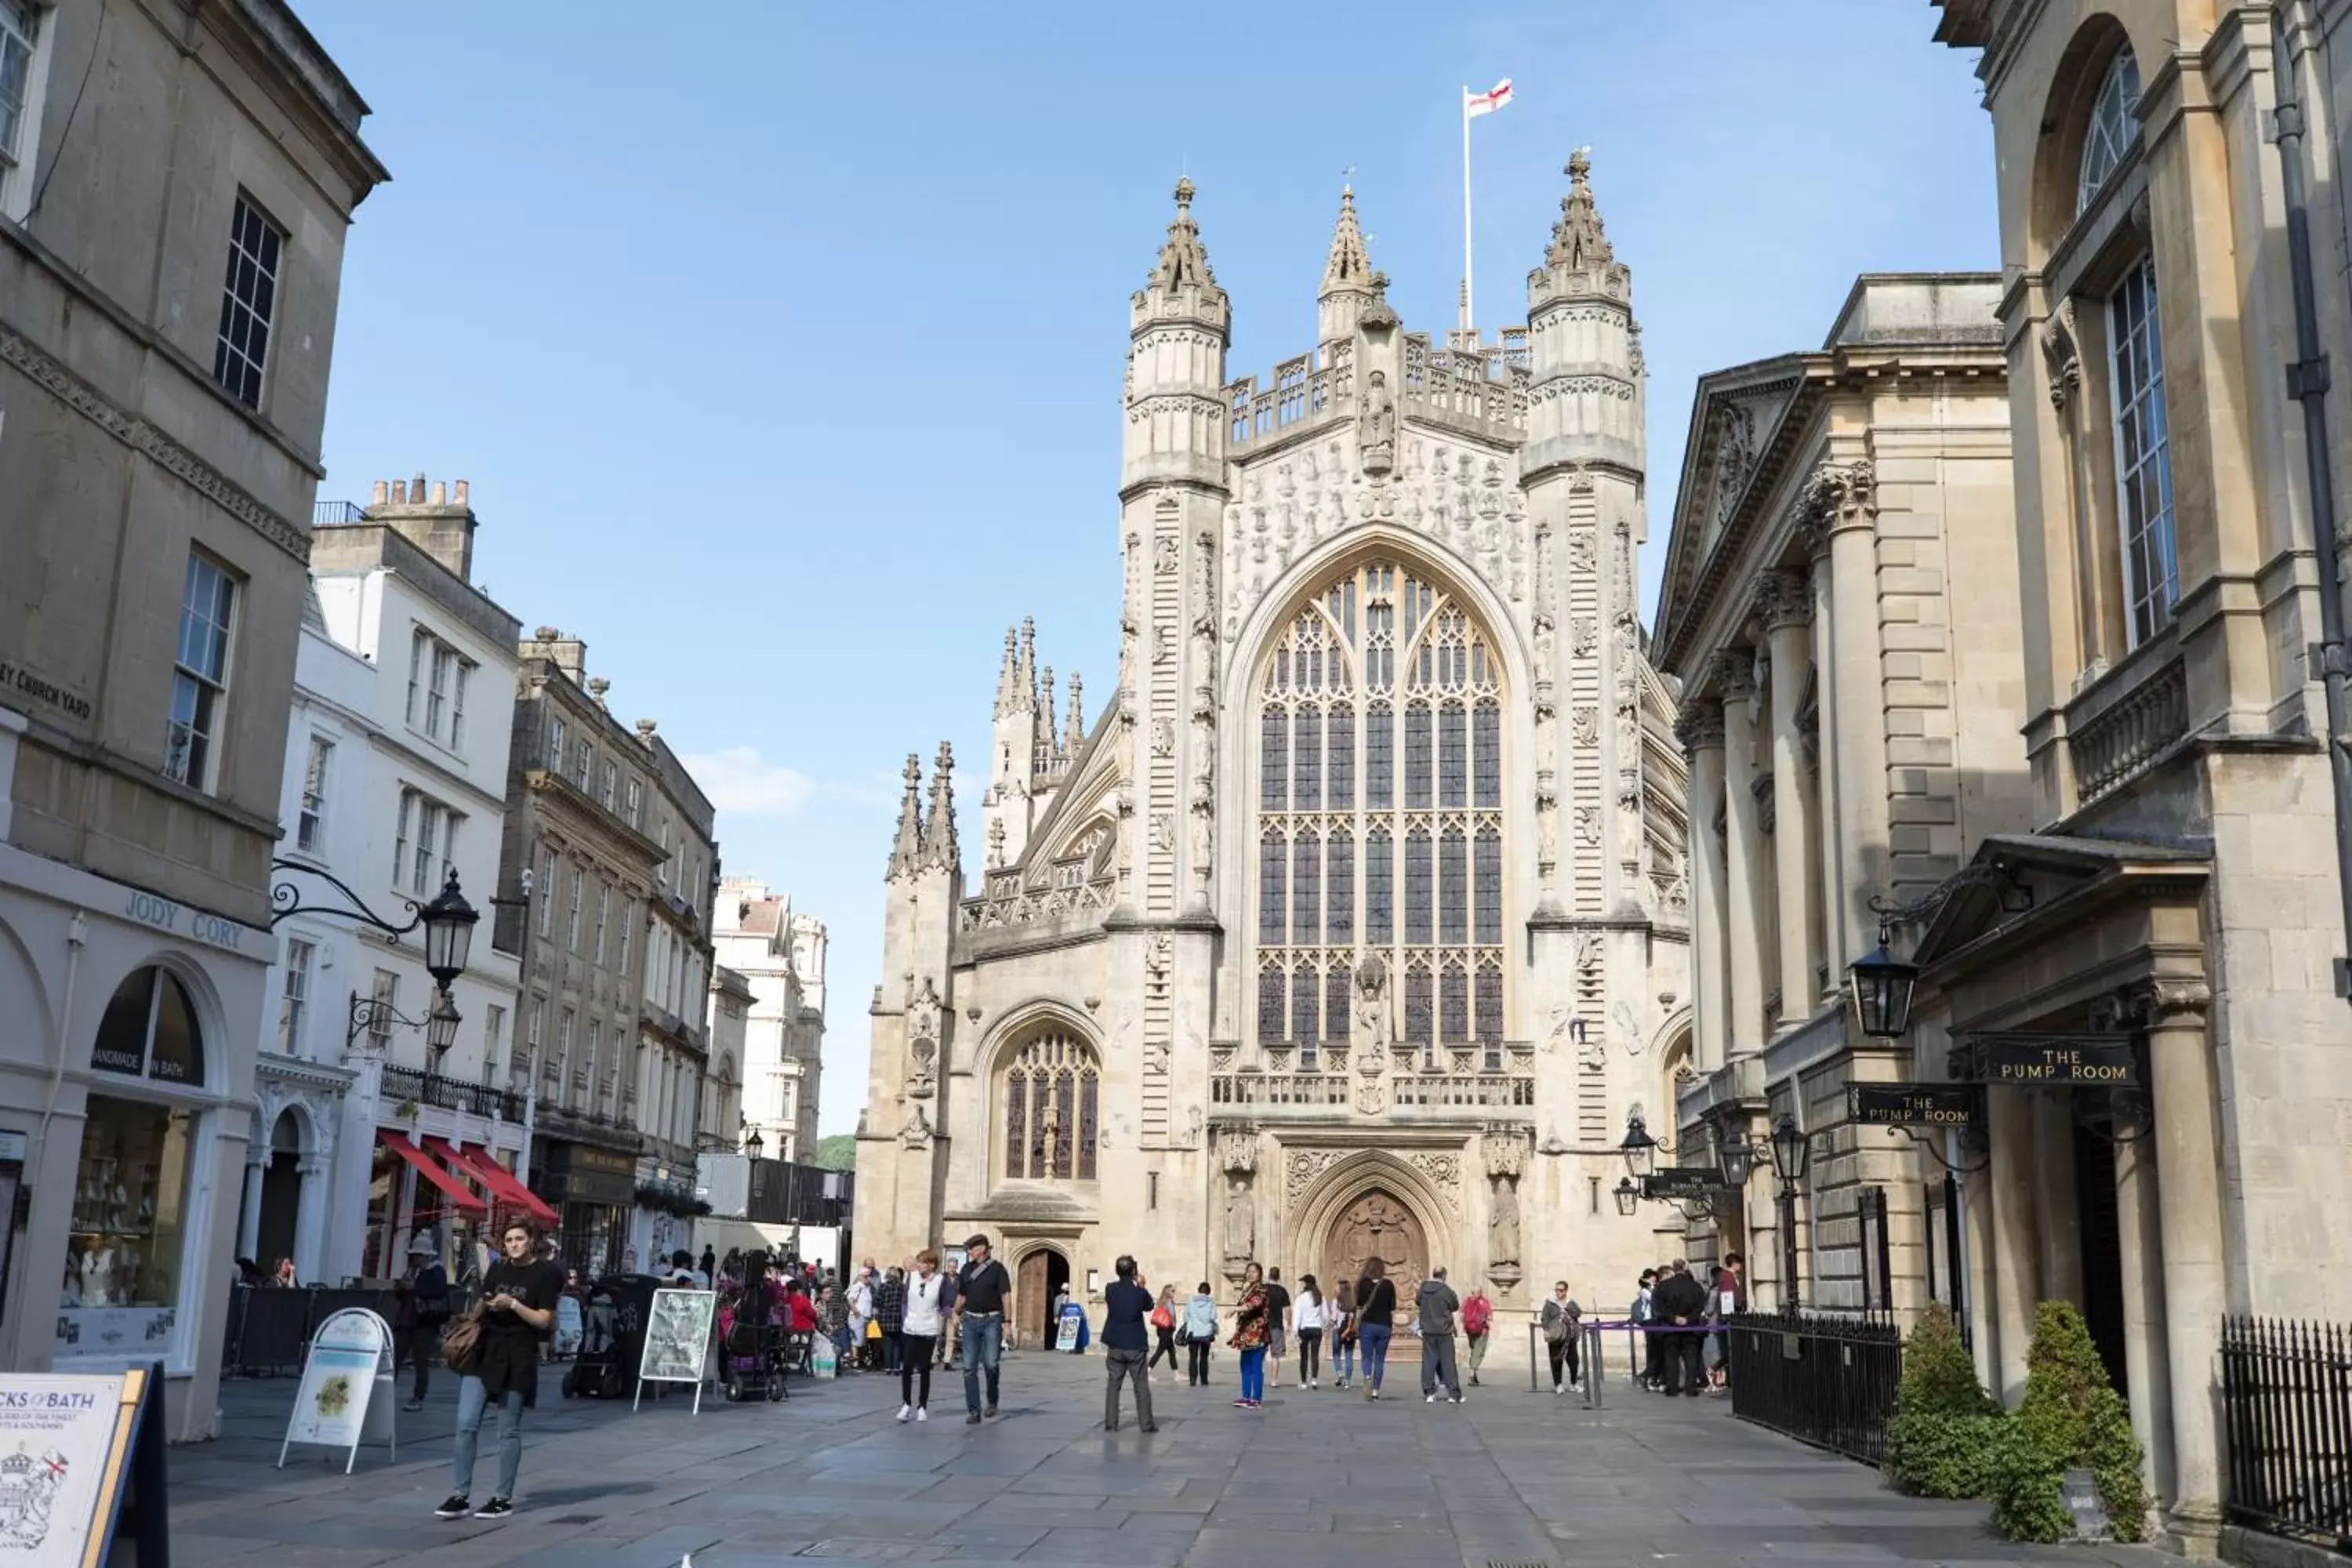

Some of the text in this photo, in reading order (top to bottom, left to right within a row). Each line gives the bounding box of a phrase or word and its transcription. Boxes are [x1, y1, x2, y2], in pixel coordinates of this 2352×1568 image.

[17, 669, 60, 706] CHURCH
[62, 690, 90, 720] YARD
[125, 891, 244, 949] JODY CORY
[2042, 1050, 2082, 1065] THE
[161, 1060, 185, 1078] BATH
[2002, 1065, 2127, 1080] PUMP ROOM
[1903, 1097, 1933, 1109] THE
[1870, 1109, 1969, 1123] PUMP ROOM
[47, 1392, 95, 1409] BATH
